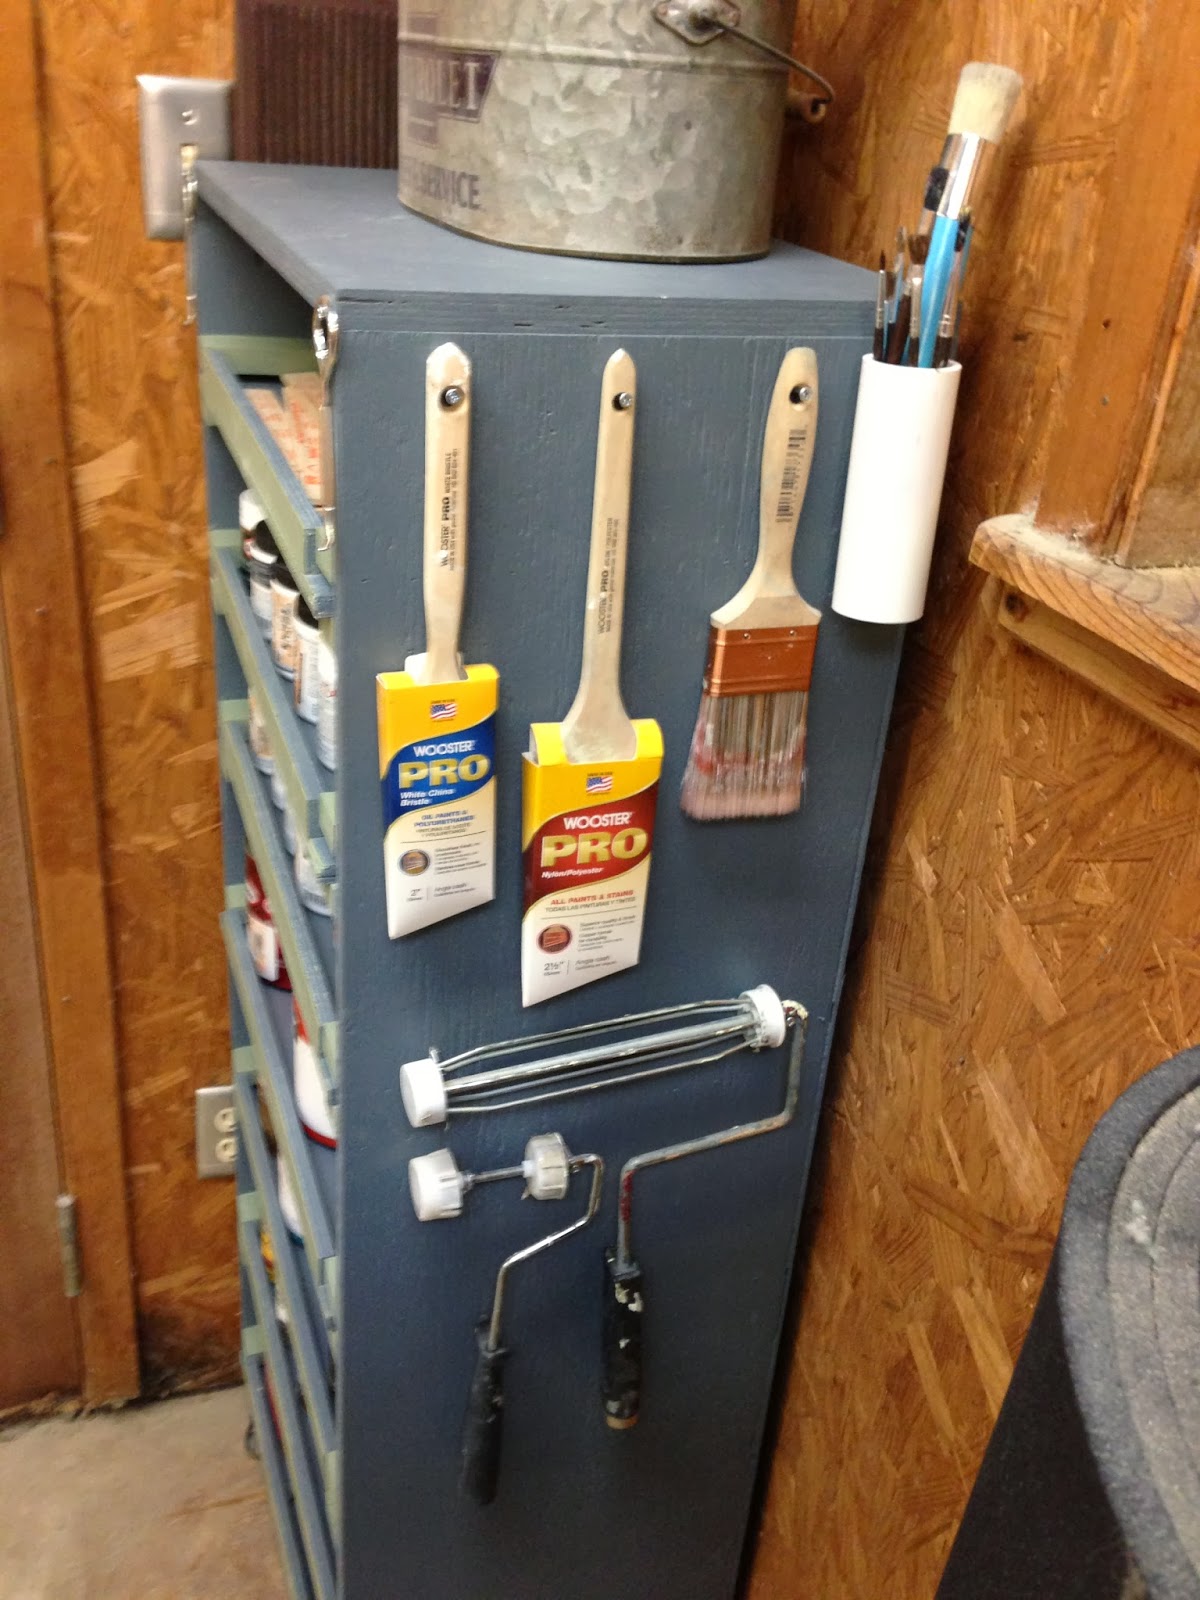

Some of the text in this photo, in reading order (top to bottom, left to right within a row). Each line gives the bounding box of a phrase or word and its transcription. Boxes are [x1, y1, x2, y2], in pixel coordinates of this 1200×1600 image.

[442, 496, 450, 521] PRO
[601, 570, 609, 592] PRO
[413, 740, 475, 757] WOOSTER
[398, 754, 491, 789] PRO
[400, 788, 454, 799] White China
[400, 798, 430, 807] Bristle
[563, 811, 633, 830] WOOSTER
[540, 827, 648, 868] PRO
[541, 867, 604, 879] Nylon/Polyester
[550, 898, 566, 906] ALL
[568, 894, 597, 904] PAINTS
[606, 889, 635, 899] STAINS
